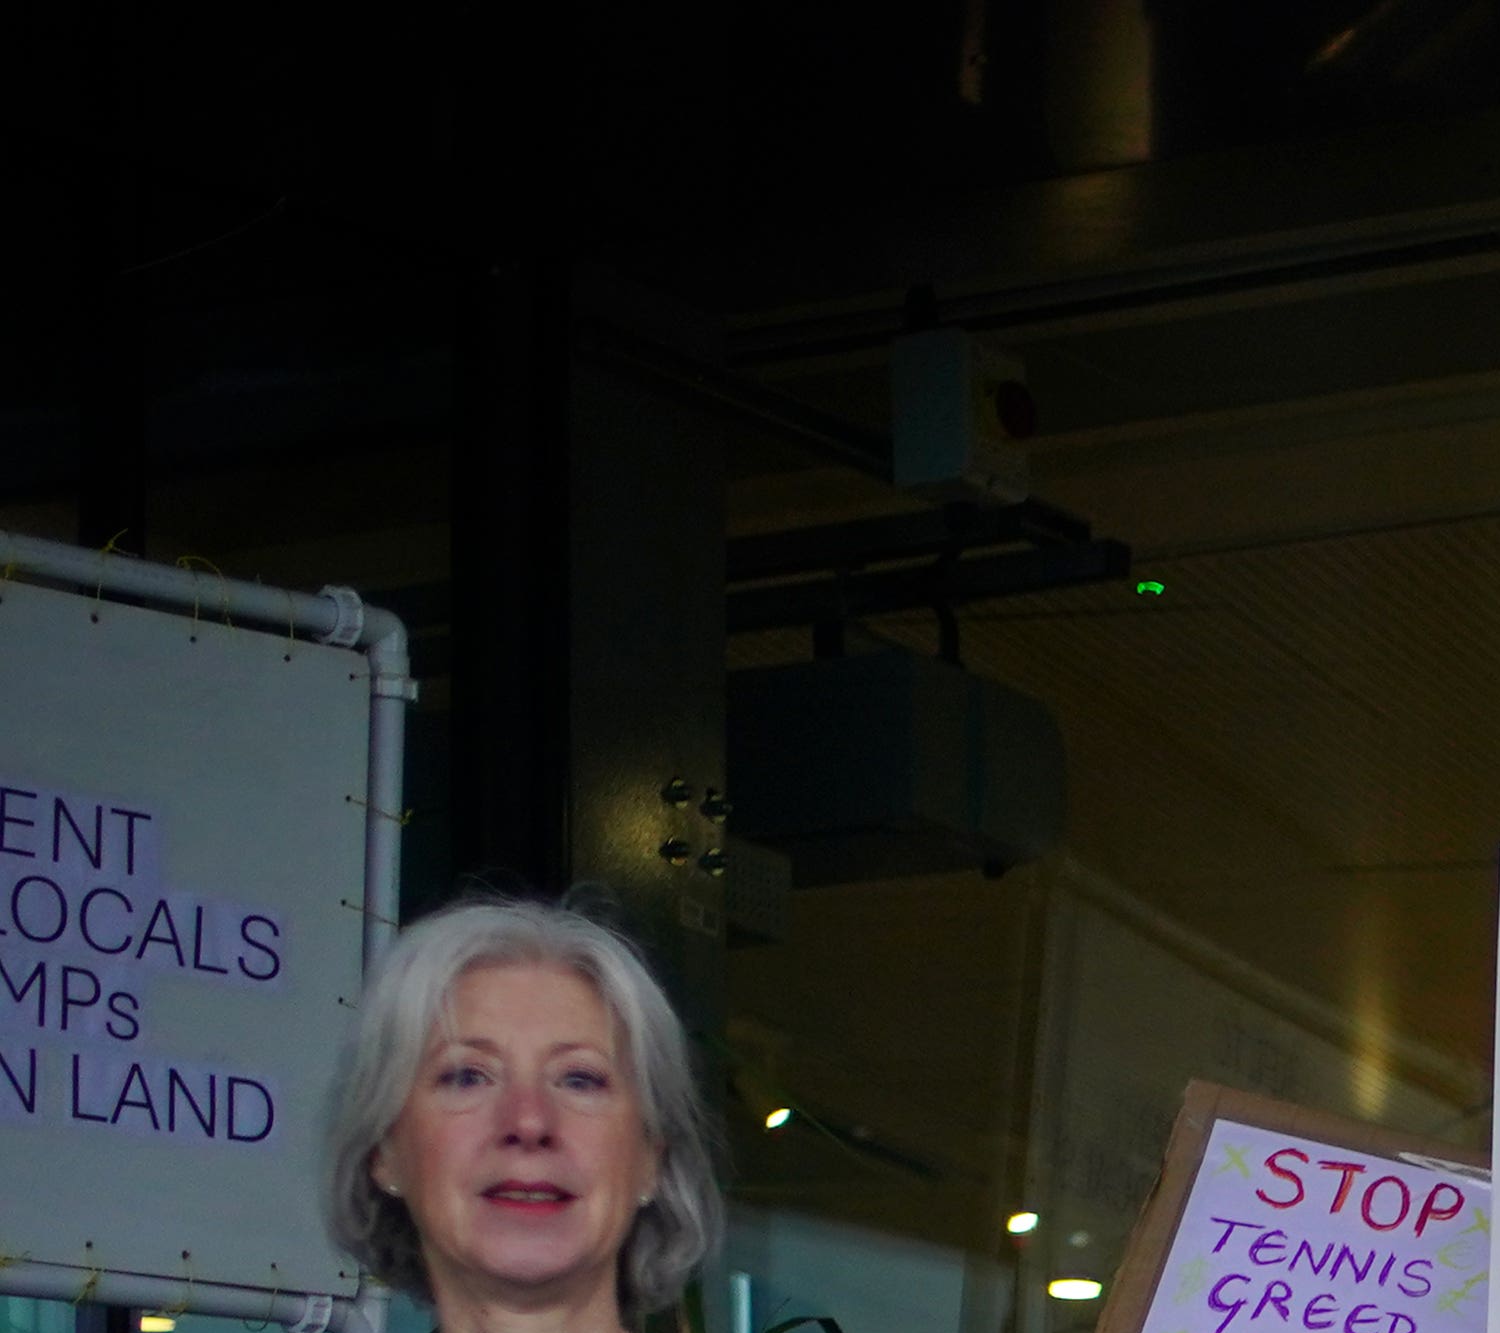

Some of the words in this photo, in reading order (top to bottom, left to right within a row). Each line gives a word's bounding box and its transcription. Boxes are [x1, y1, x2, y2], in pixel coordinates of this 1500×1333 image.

[0, 875, 280, 980] OCALS
[73, 1053, 274, 1142] LAND
[1255, 1148, 1466, 1238] STOP
[1210, 1217, 1433, 1297] TENNIS
